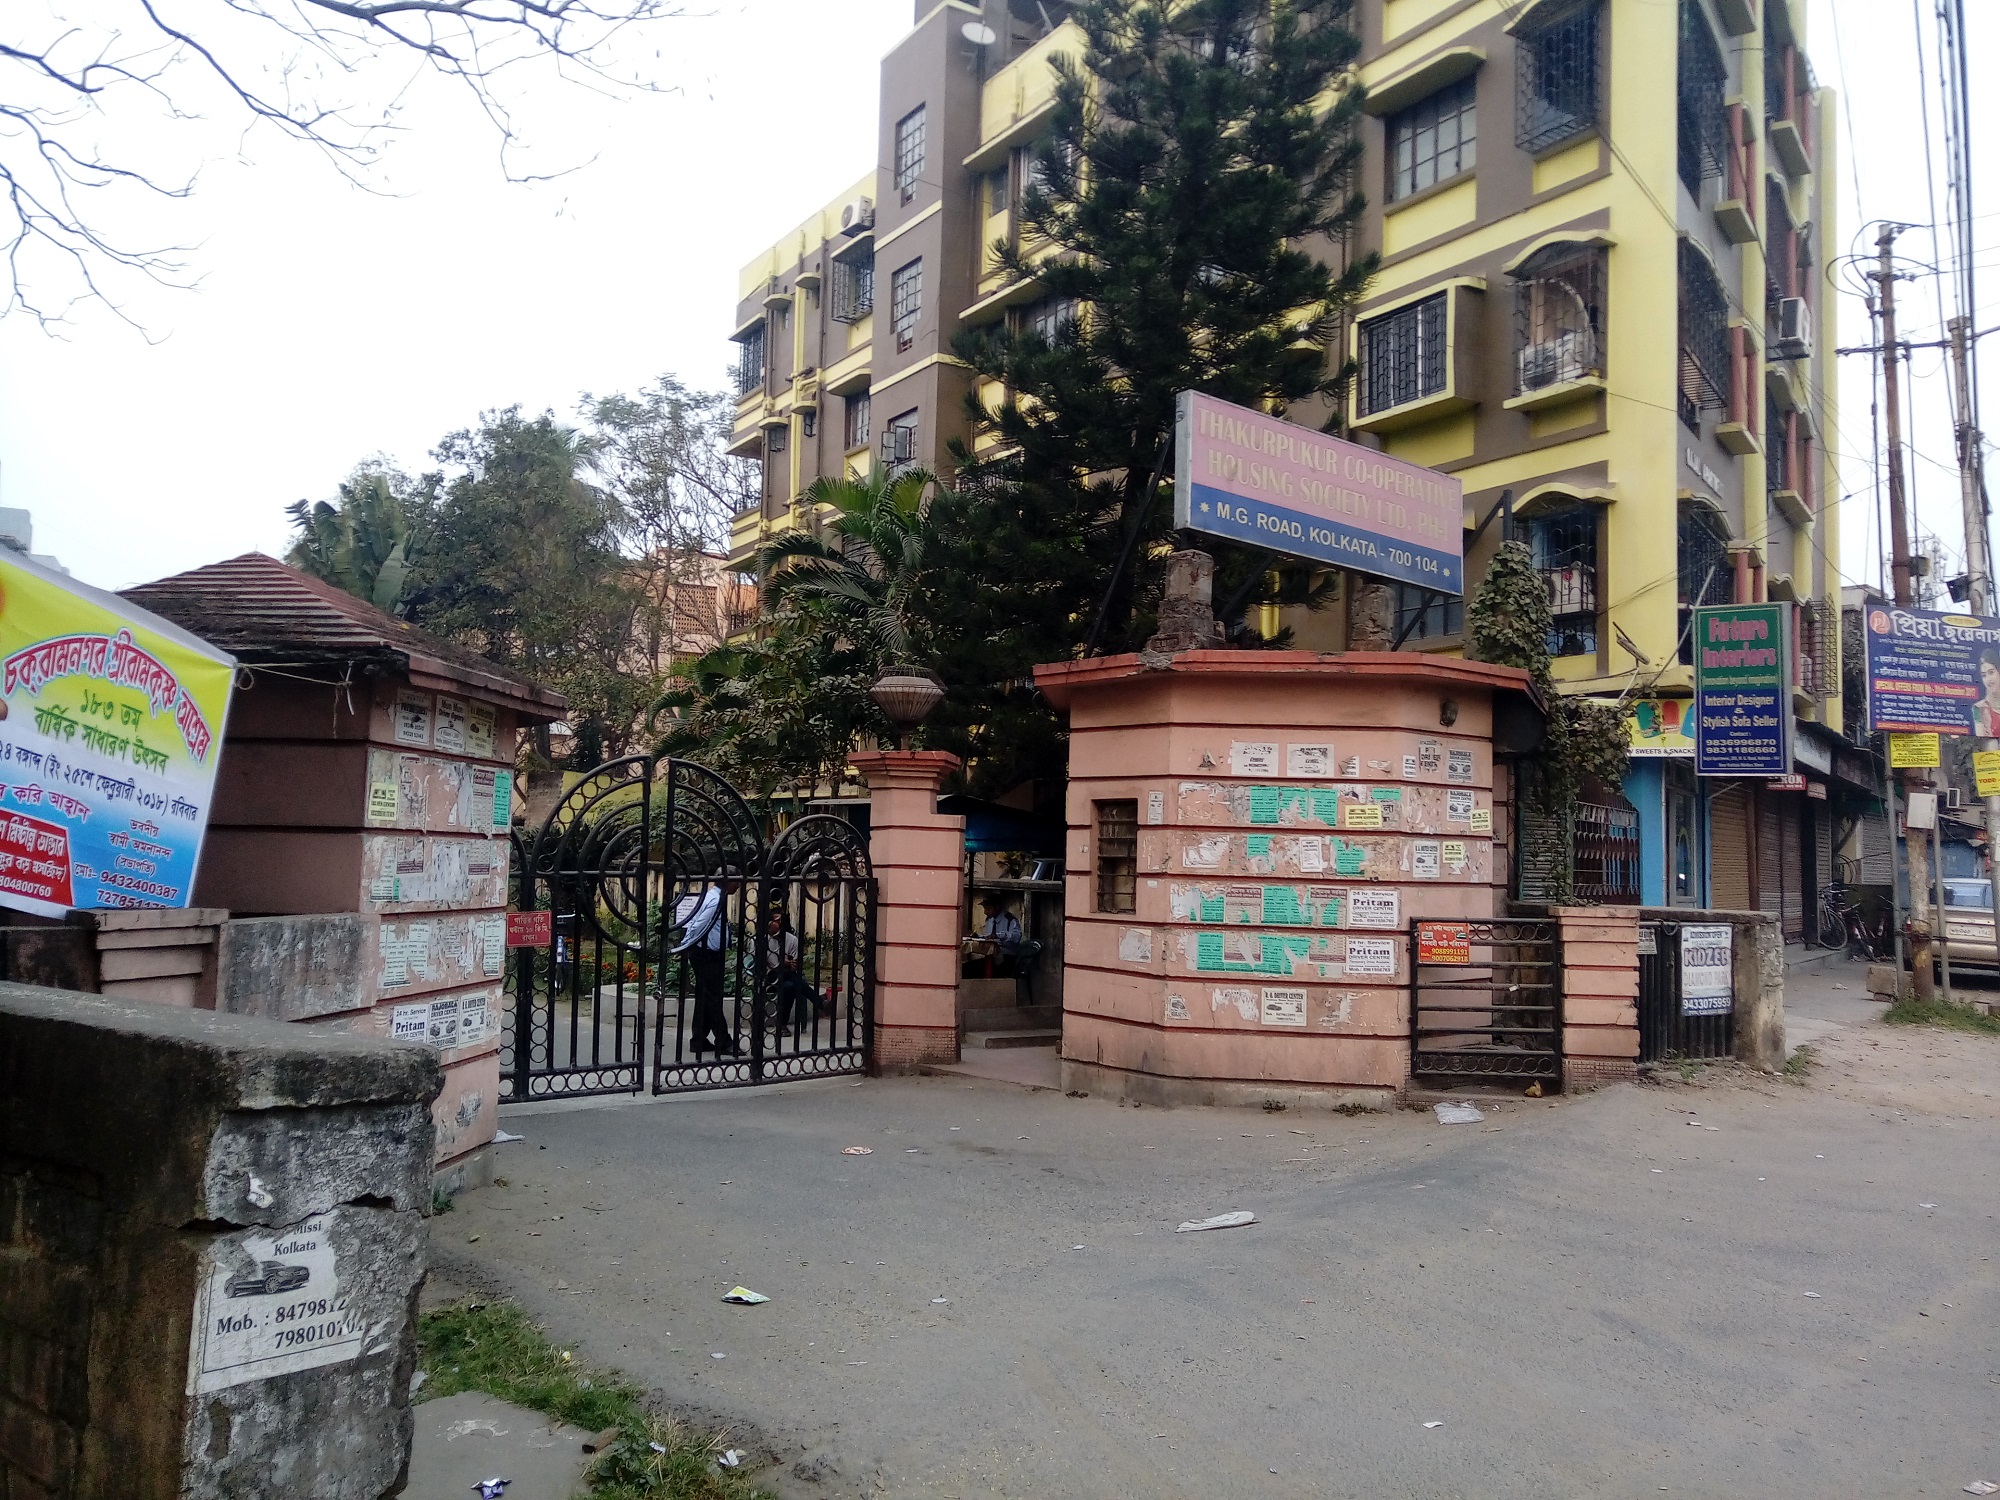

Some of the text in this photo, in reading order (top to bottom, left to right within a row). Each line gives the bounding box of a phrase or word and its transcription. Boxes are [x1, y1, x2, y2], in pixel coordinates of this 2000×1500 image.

[1198, 407, 1458, 512] THAKURPUKUR CO-OPERATIVE
[1208, 449, 1294, 498] HOUSING
[1300, 476, 1369, 520] SOCIETY
[1377, 500, 1412, 531] LTD.
[1217, 502, 1252, 526] M.G.
[1257, 513, 1305, 542] ROAD,
[1309, 526, 1377, 559] KOLKATA
[1388, 547, 1411, 568] 700
[1414, 554, 1439, 574] 104
[1709, 616, 1768, 642] Future
[1702, 641, 1777, 668] Interiors
[108, 630, 177, 716] শ্রীরামকৃষ্ণ
[178, 689, 210, 762] আশ্রম
[1705, 694, 1775, 708] Interior Designer
[80, 690, 143, 730] ১৮৩ তম
[1703, 715, 1778, 730] Stylish Sofa Seller
[34, 704, 169, 774] বার্ষিক সাধারণ উৎসব
[12, 783, 43, 802] করি
[64, 764, 95, 788] ২৫শে
[171, 796, 198, 821] রবিবার
[100, 871, 178, 899] 9432400387
[1353, 898, 1394, 906] Pritam
[1349, 947, 1390, 955] Pritam
[410, 1008, 426, 1016] Service
[395, 1021, 425, 1033] Pritam
[273, 1240, 316, 1257] Kolkata
[216, 1314, 257, 1335] Mob.
